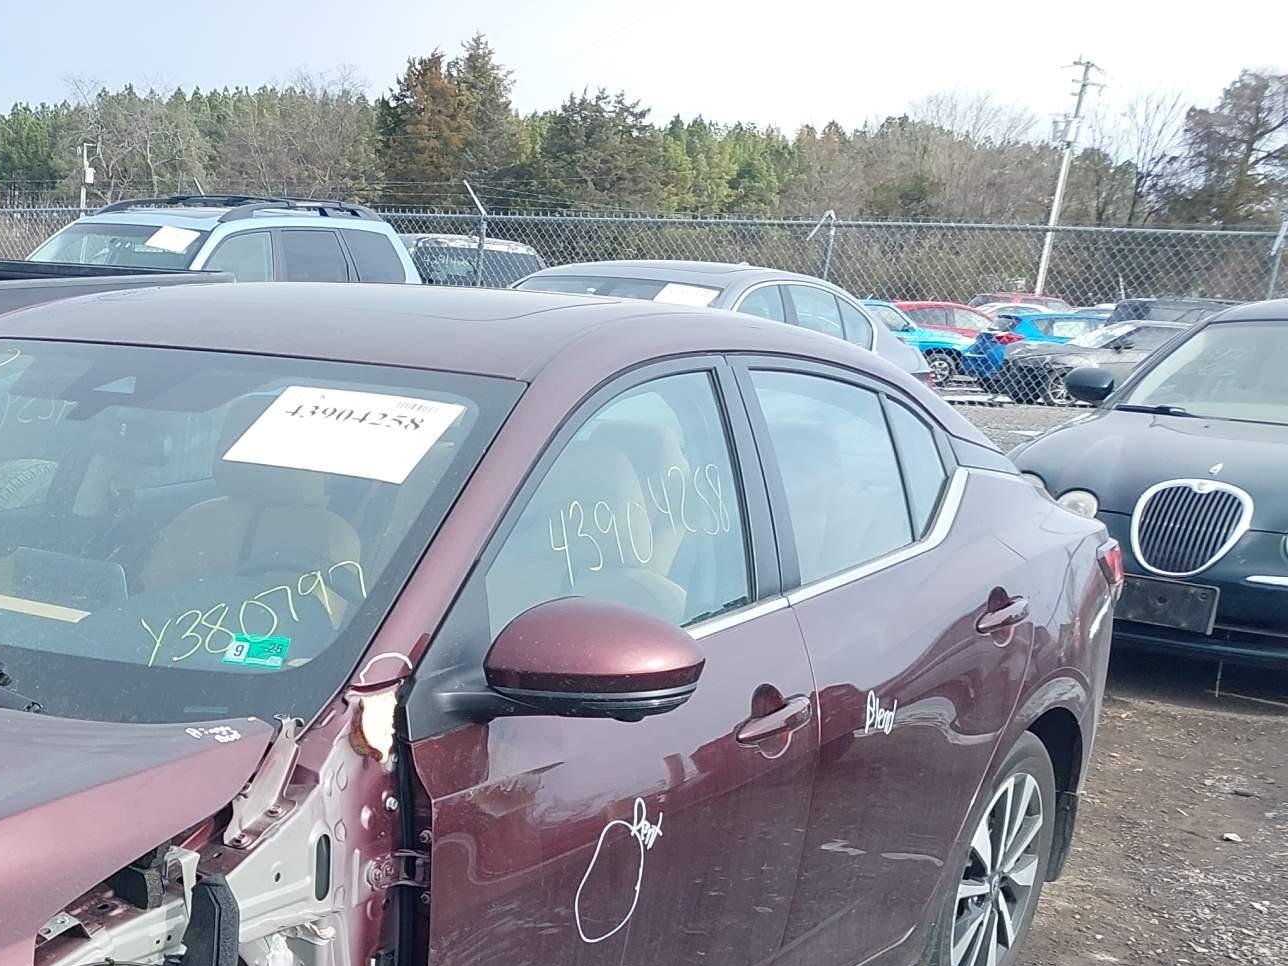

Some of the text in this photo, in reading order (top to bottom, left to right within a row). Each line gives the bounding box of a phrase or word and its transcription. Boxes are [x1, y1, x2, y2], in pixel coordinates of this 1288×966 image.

[285, 403, 425, 431] 43904258
[548, 463, 730, 588] 43904258
[140, 560, 368, 668] Y380797
[233, 644, 245, 657] 9
